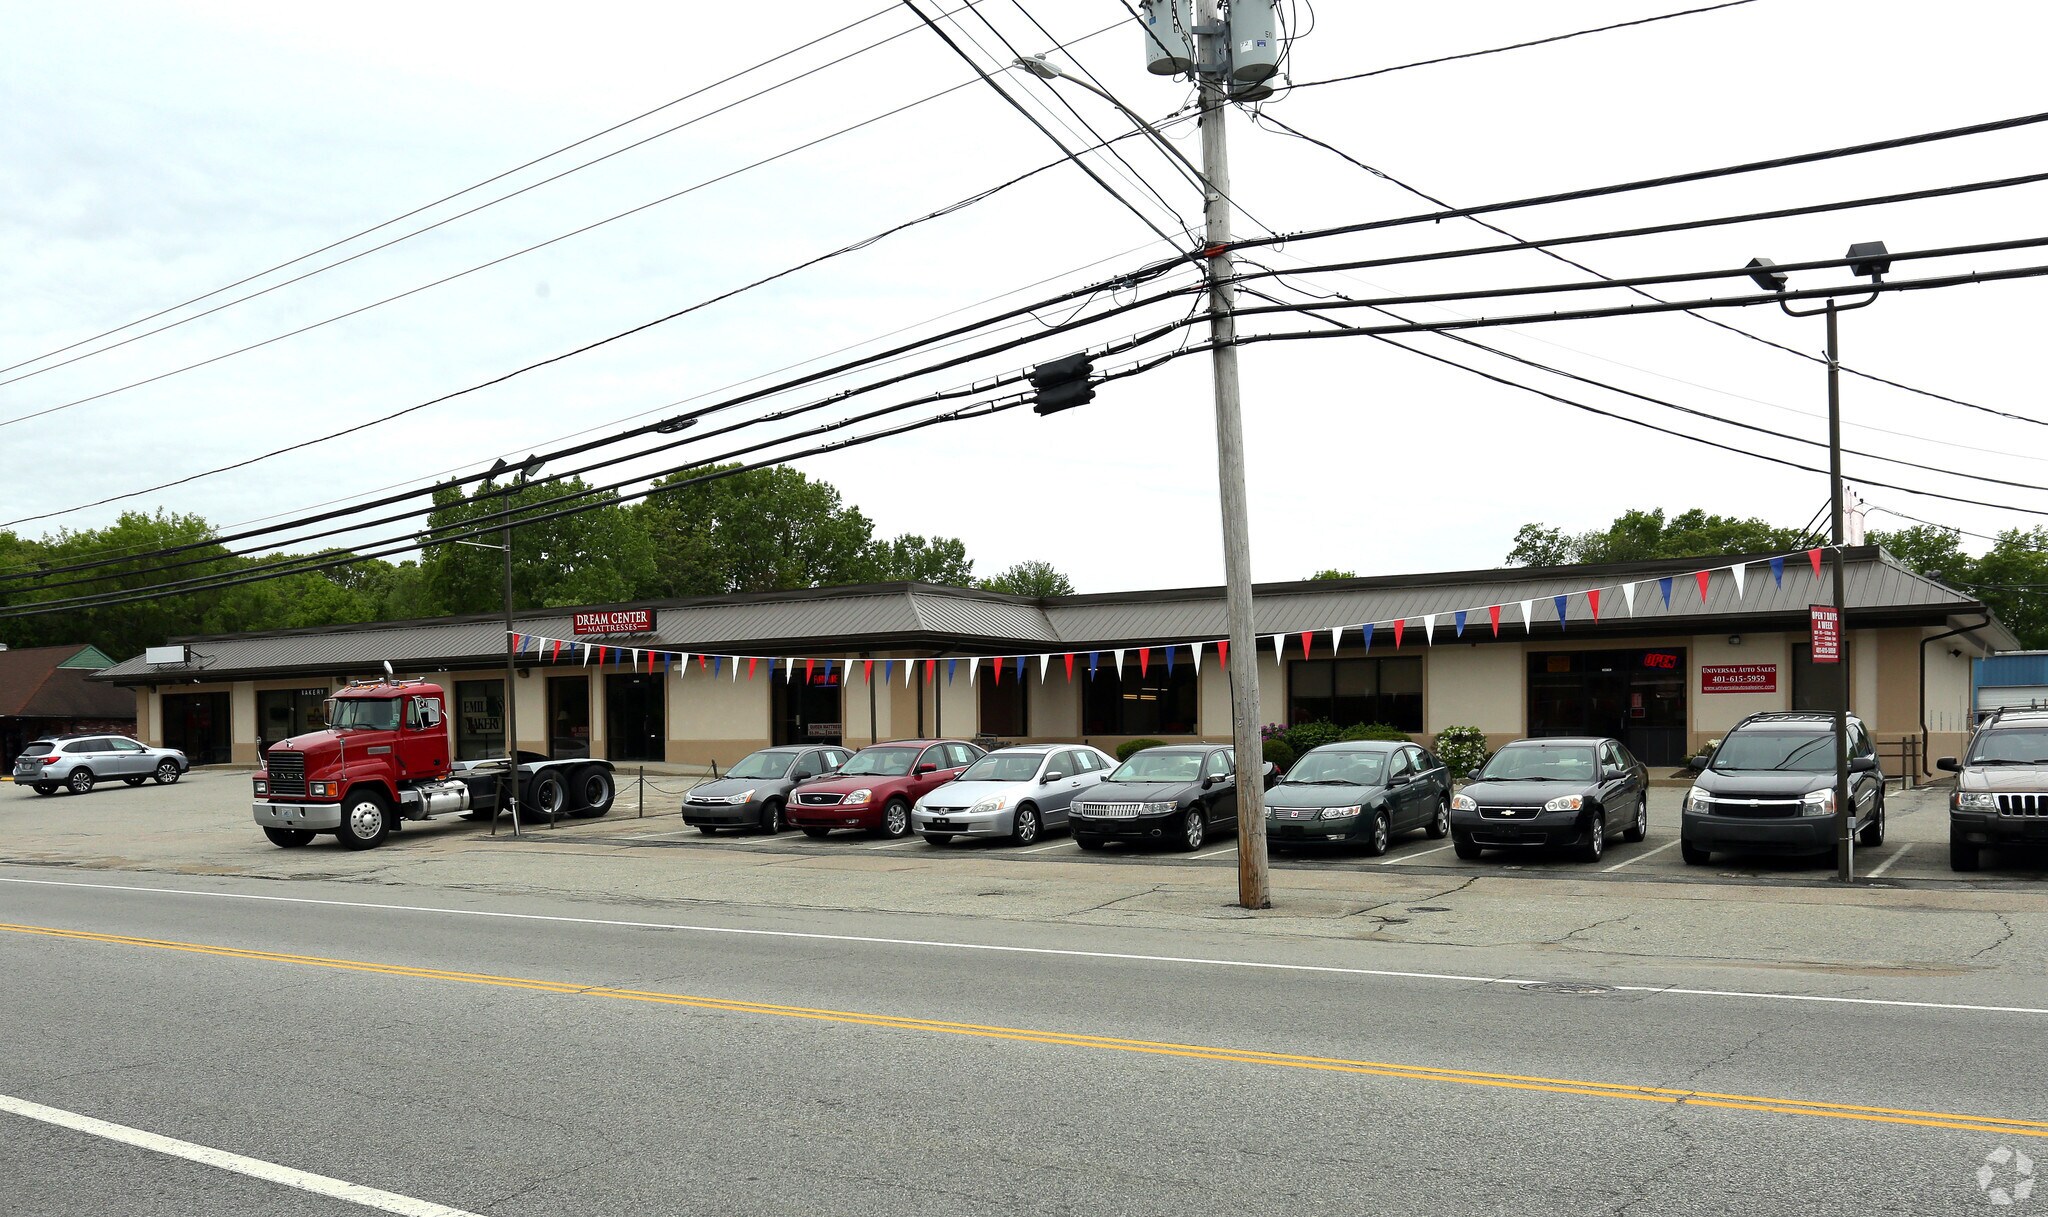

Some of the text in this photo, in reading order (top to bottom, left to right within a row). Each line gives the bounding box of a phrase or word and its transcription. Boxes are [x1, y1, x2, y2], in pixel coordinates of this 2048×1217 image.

[577, 611, 647, 626] DREAM CENTER
[1812, 611, 1823, 620] OPEN
[587, 623, 637, 632] MATTRESSES
[1821, 621, 1833, 629] WEEK
[1644, 653, 1677, 669] OPEN
[1712, 675, 1766, 683] 401-615-5959
